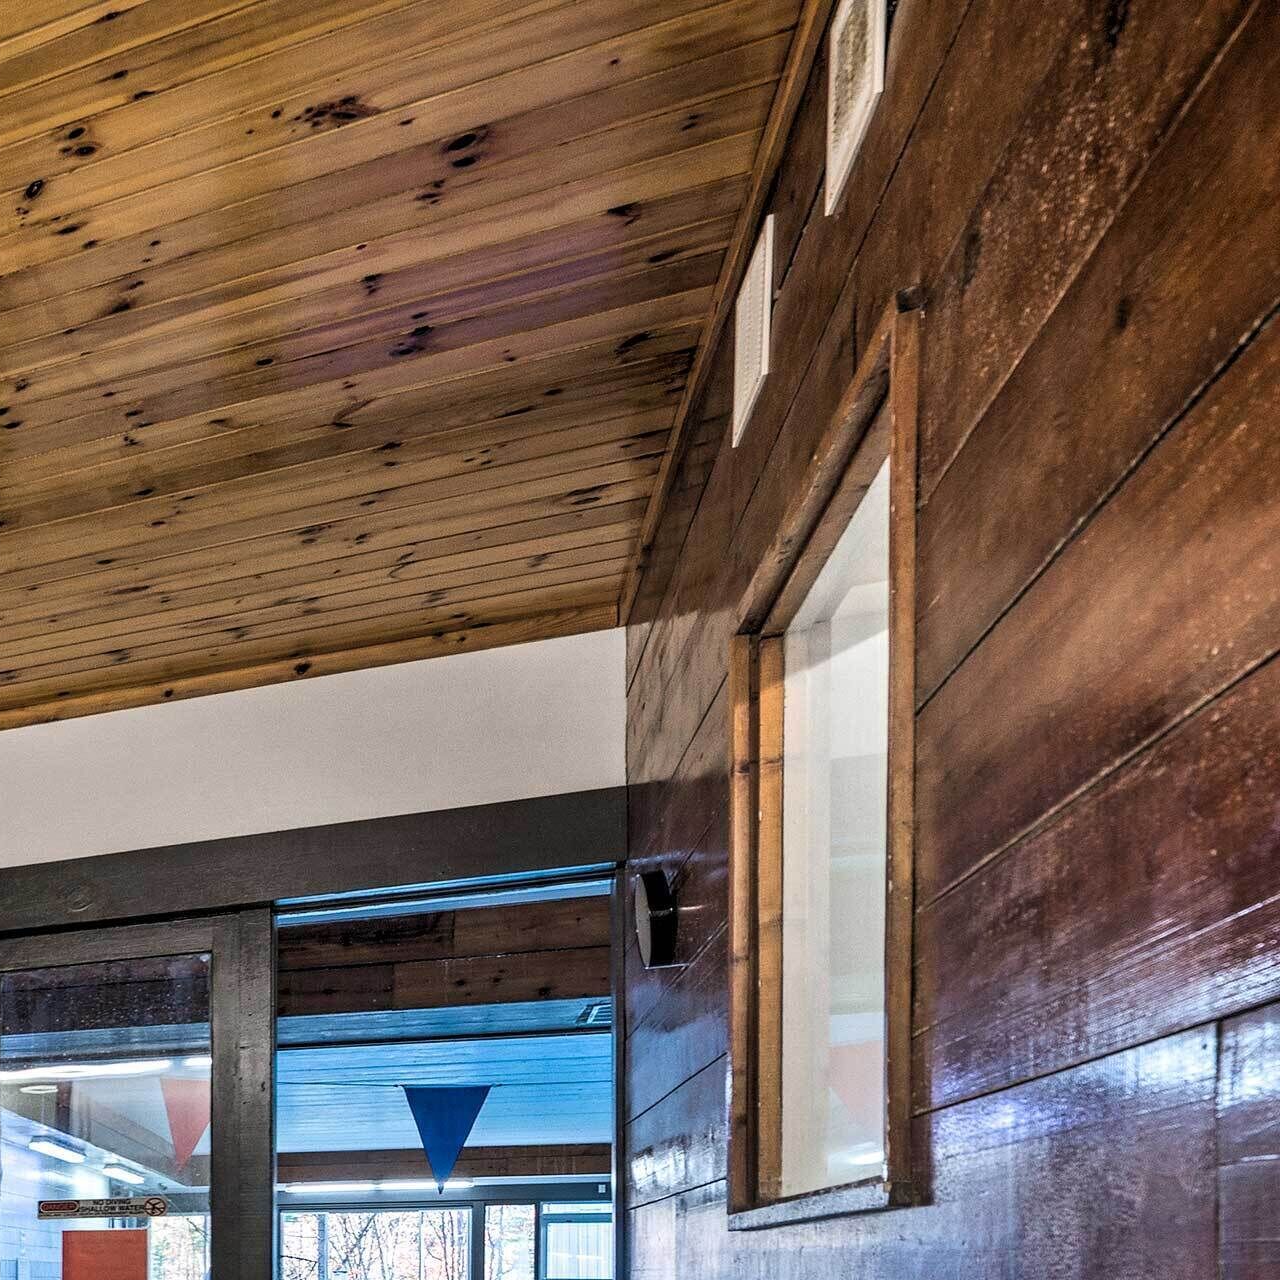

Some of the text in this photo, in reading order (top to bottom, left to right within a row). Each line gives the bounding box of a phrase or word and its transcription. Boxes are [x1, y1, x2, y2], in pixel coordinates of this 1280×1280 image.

[43, 1203, 75, 1211] DANGER
[79, 1204, 144, 1213] SHALLOW WATER
